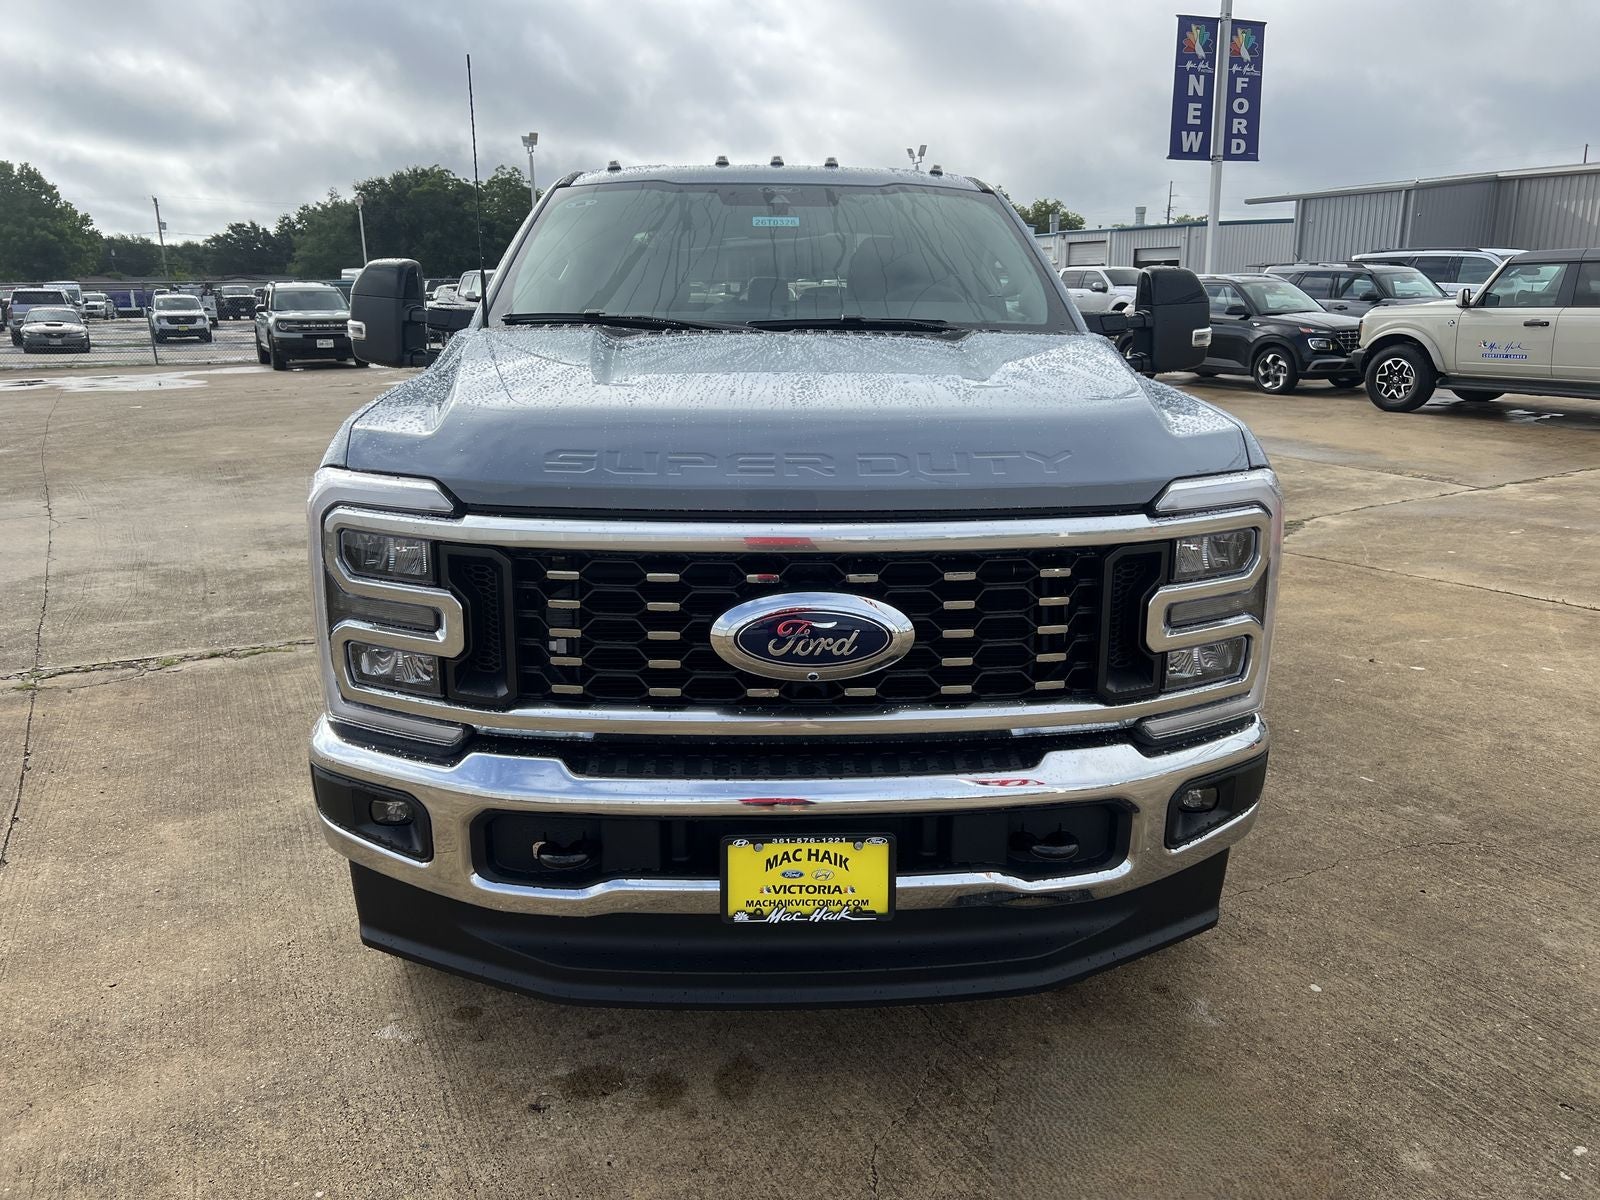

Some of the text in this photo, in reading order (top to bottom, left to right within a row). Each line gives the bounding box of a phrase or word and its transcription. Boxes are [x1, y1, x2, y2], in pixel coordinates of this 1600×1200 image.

[1181, 74, 1205, 153] NEW
[1230, 77, 1250, 155] FORD
[543, 449, 1073, 477] SUPER DUTY
[767, 619, 861, 657] Ford
[765, 848, 850, 873] MAC HAIK
[772, 884, 843, 895] VICTORIA
[745, 899, 869, 908] MACHAIKVICTORIA.COM
[764, 906, 852, 923] Mac Haik
